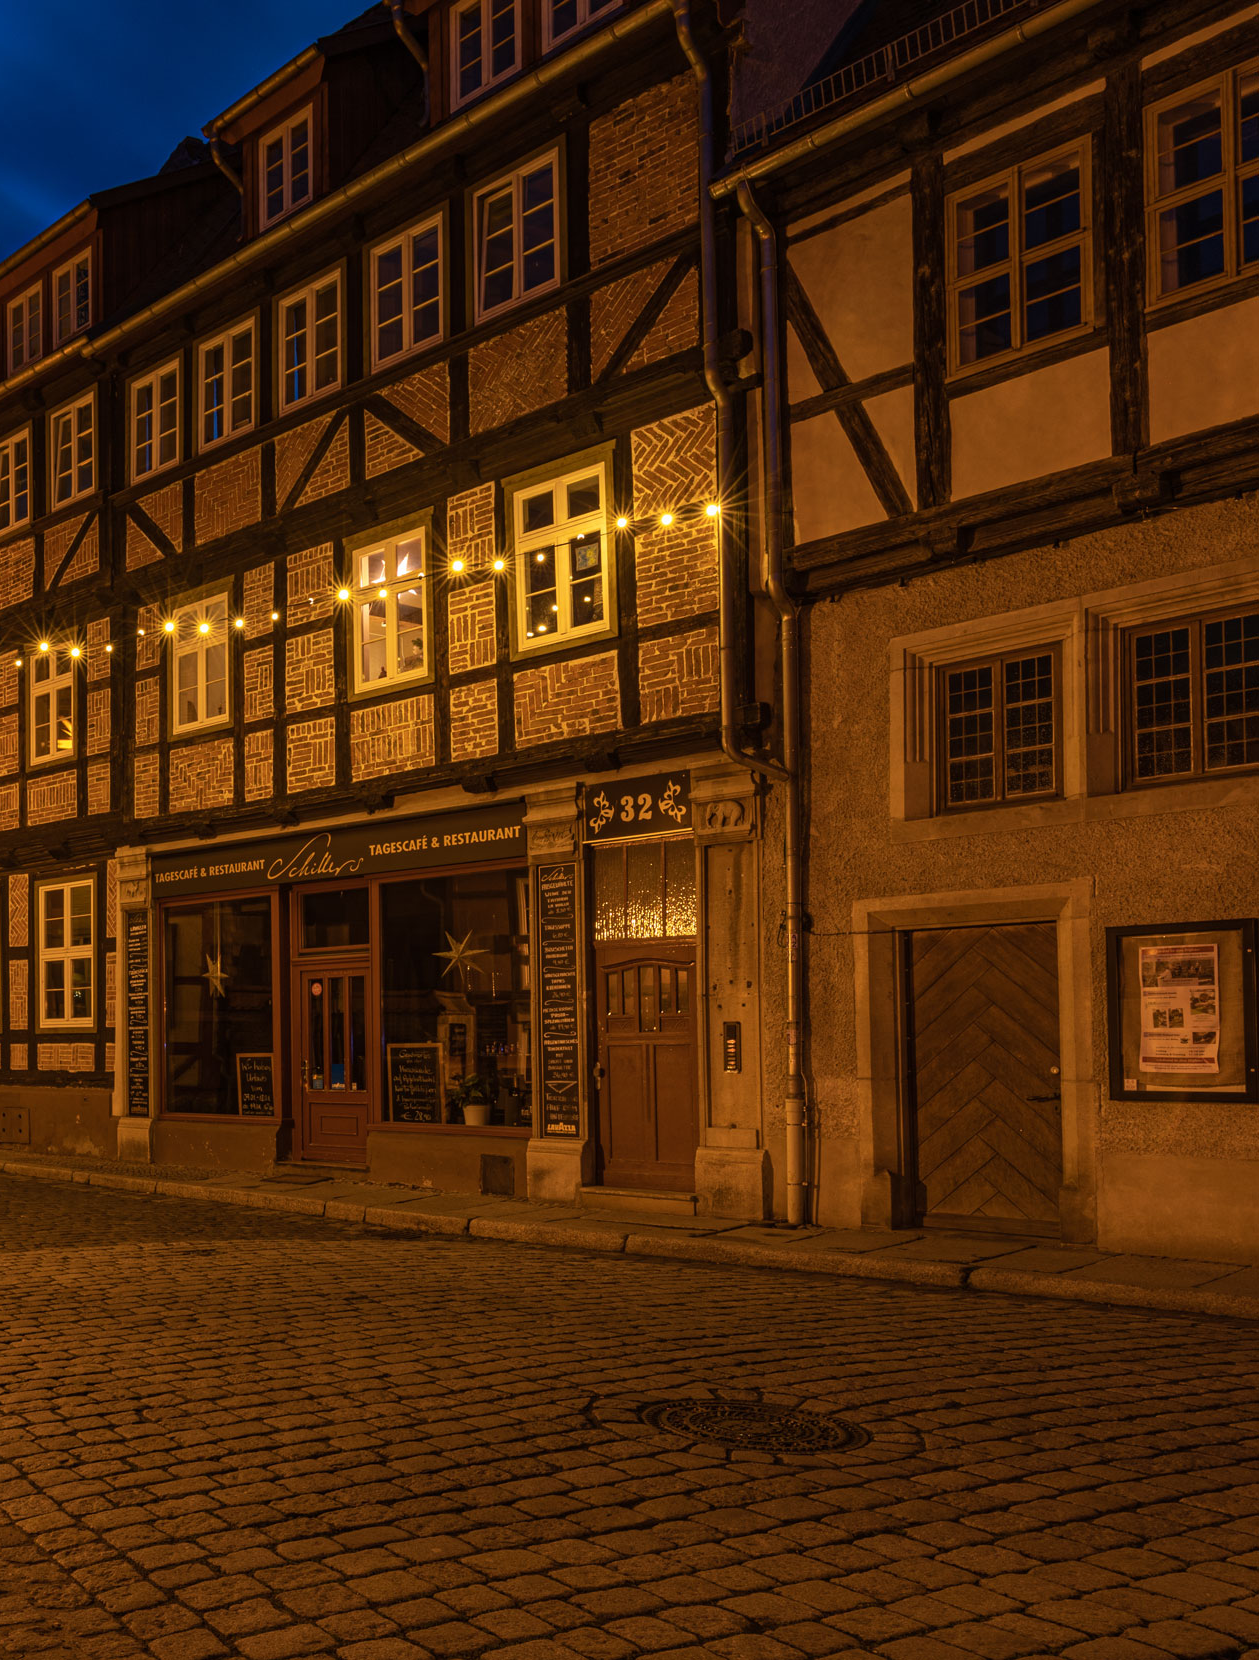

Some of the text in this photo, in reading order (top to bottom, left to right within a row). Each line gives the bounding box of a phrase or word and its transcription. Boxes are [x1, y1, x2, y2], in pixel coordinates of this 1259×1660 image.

[620, 793, 652, 822] 32
[155, 866, 198, 883] TAGESCAFÉ
[200, 867, 207, 878] &
[209, 859, 266, 877] RESTAURANT
[369, 835, 428, 856] TAGESCAFÉ
[430, 836, 440, 848] &
[443, 825, 521, 847] RESTAURANT
